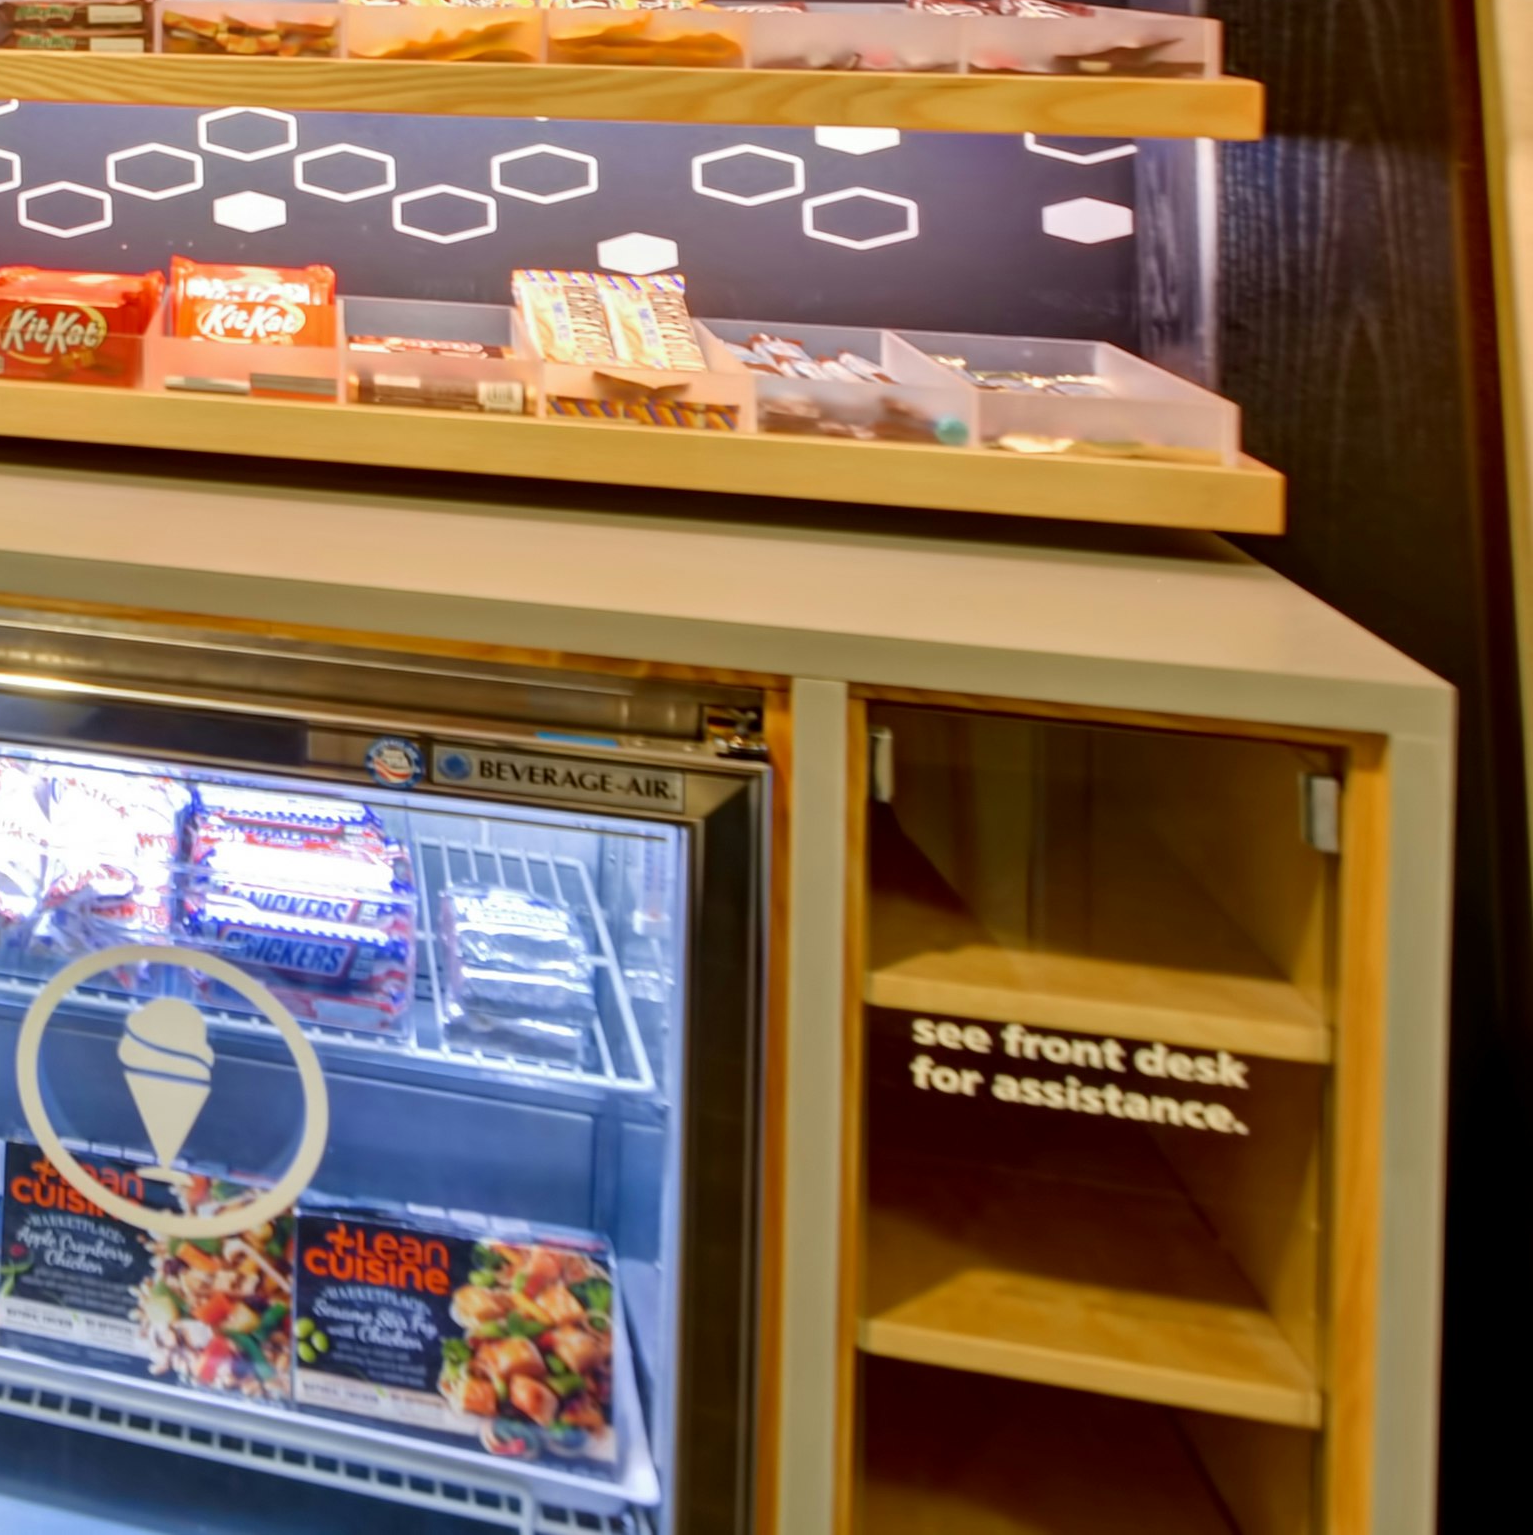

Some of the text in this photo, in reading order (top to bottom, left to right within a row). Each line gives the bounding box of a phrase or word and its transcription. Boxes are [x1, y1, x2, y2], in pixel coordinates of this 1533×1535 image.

[478, 759, 673, 800] BEVERAGE-AIR
[911, 1018, 1250, 1090] see front desk
[908, 1053, 1251, 1137] for assistance.
[16, 1226, 134, 1268] Apple Cranberry
[355, 1229, 450, 1270] Lean
